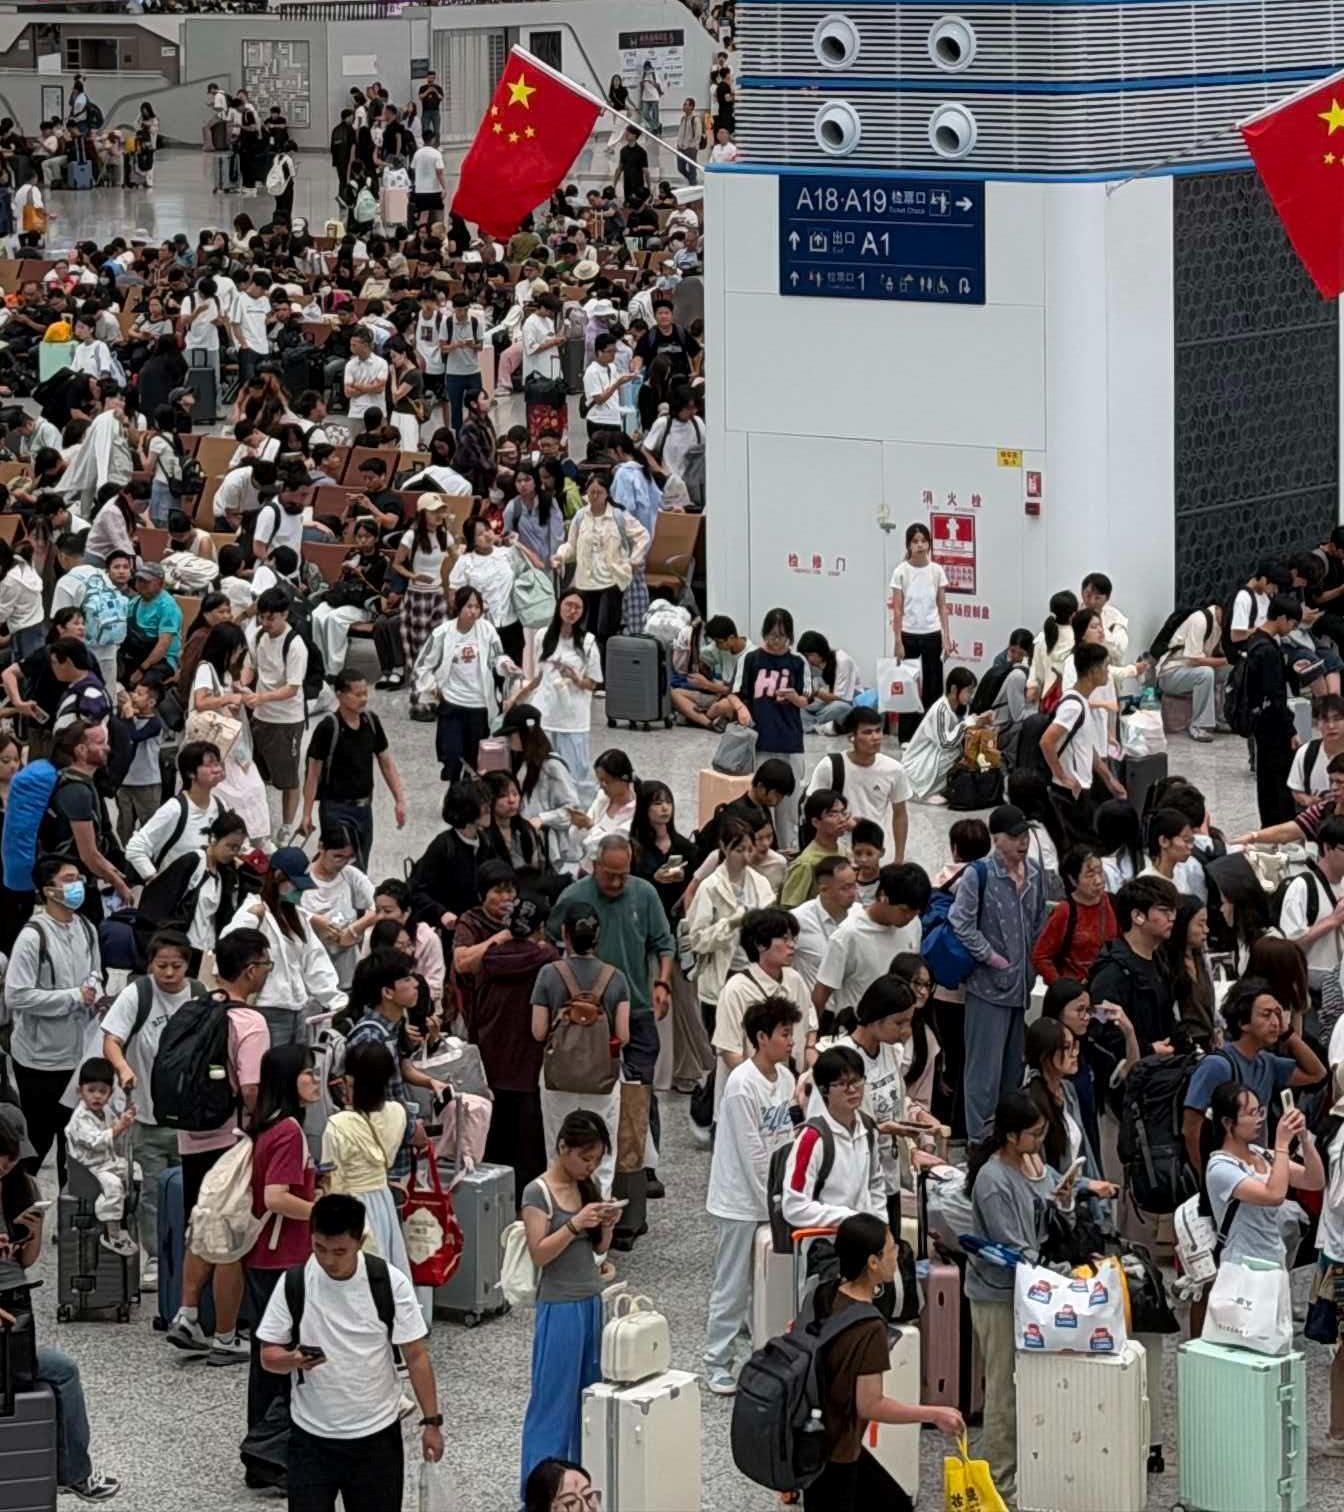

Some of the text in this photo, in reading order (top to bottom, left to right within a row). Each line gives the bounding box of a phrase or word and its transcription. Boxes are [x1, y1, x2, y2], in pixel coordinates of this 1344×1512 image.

[796, 188, 887, 213] A18·A19
[832, 231, 890, 256] 出口 A1
[857, 273, 865, 290] 1
[753, 668, 790, 698] Hi
